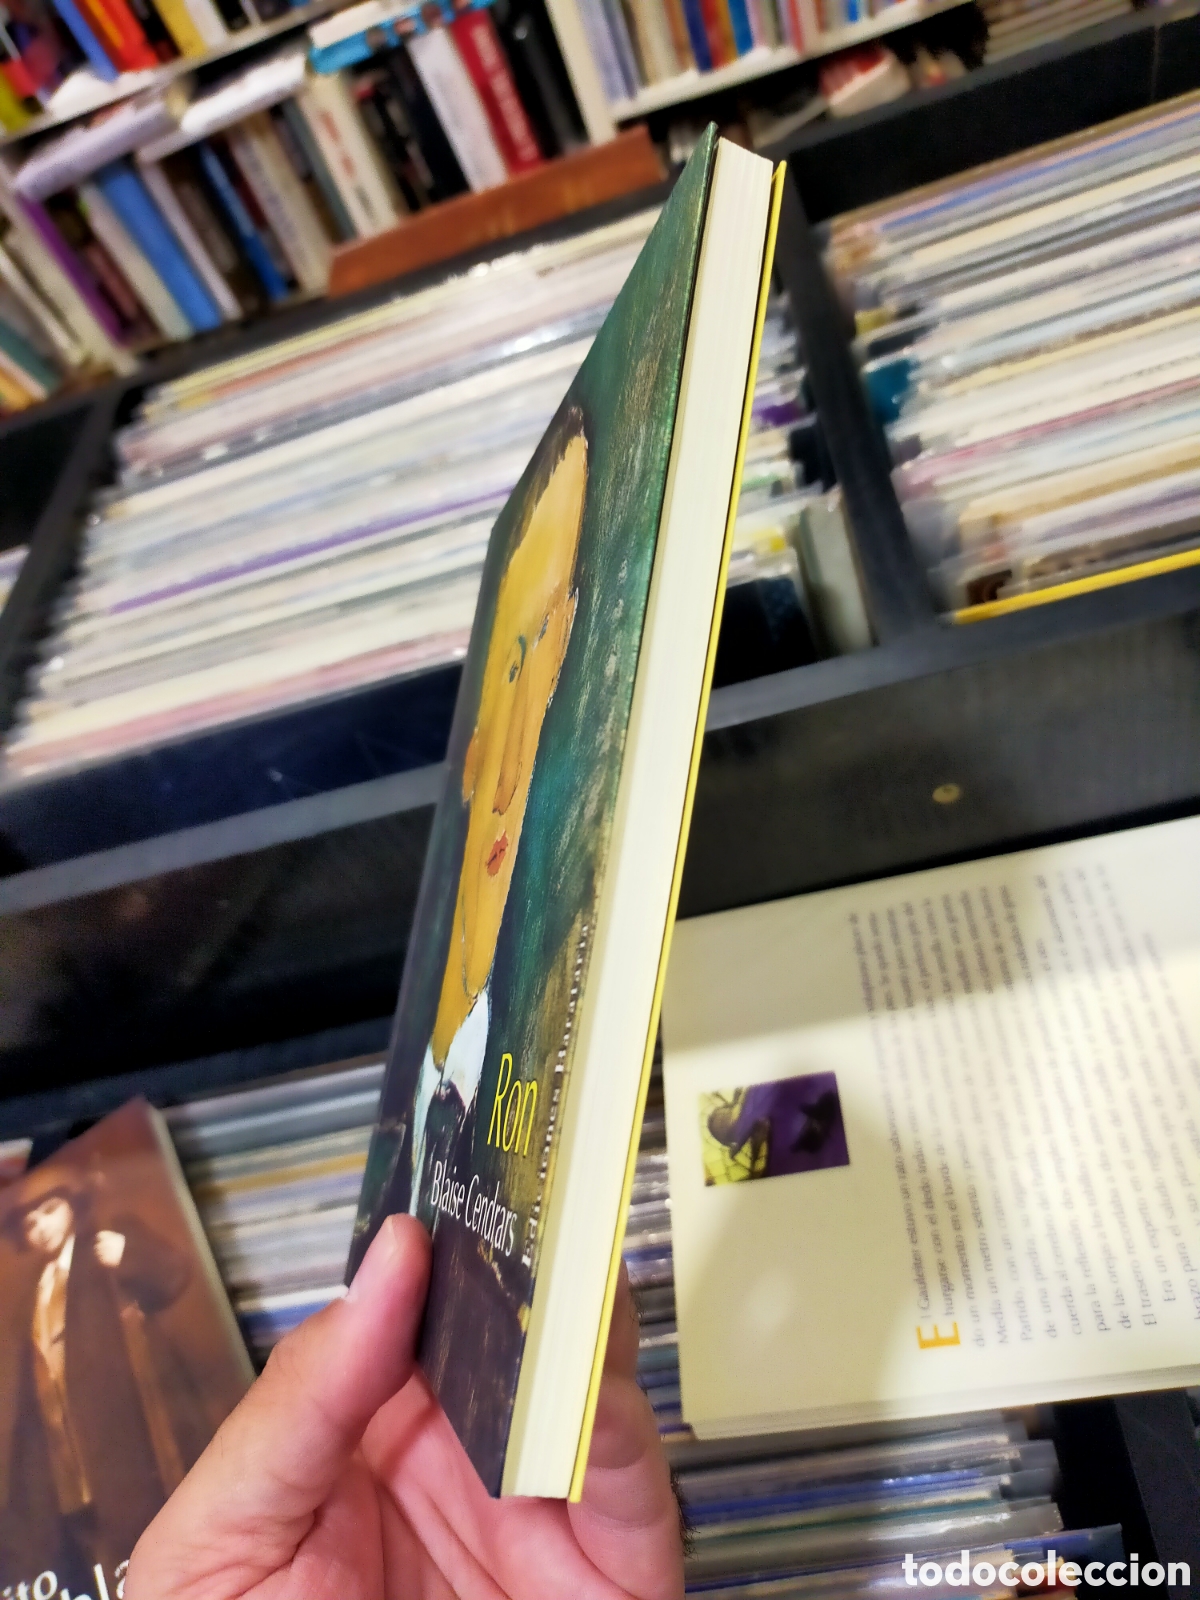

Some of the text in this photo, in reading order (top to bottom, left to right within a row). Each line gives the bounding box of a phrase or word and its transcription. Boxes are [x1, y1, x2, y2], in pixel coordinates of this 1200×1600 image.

[487, 1052, 538, 1158] Ron
[430, 1160, 518, 1257] Blaise Cendrars
